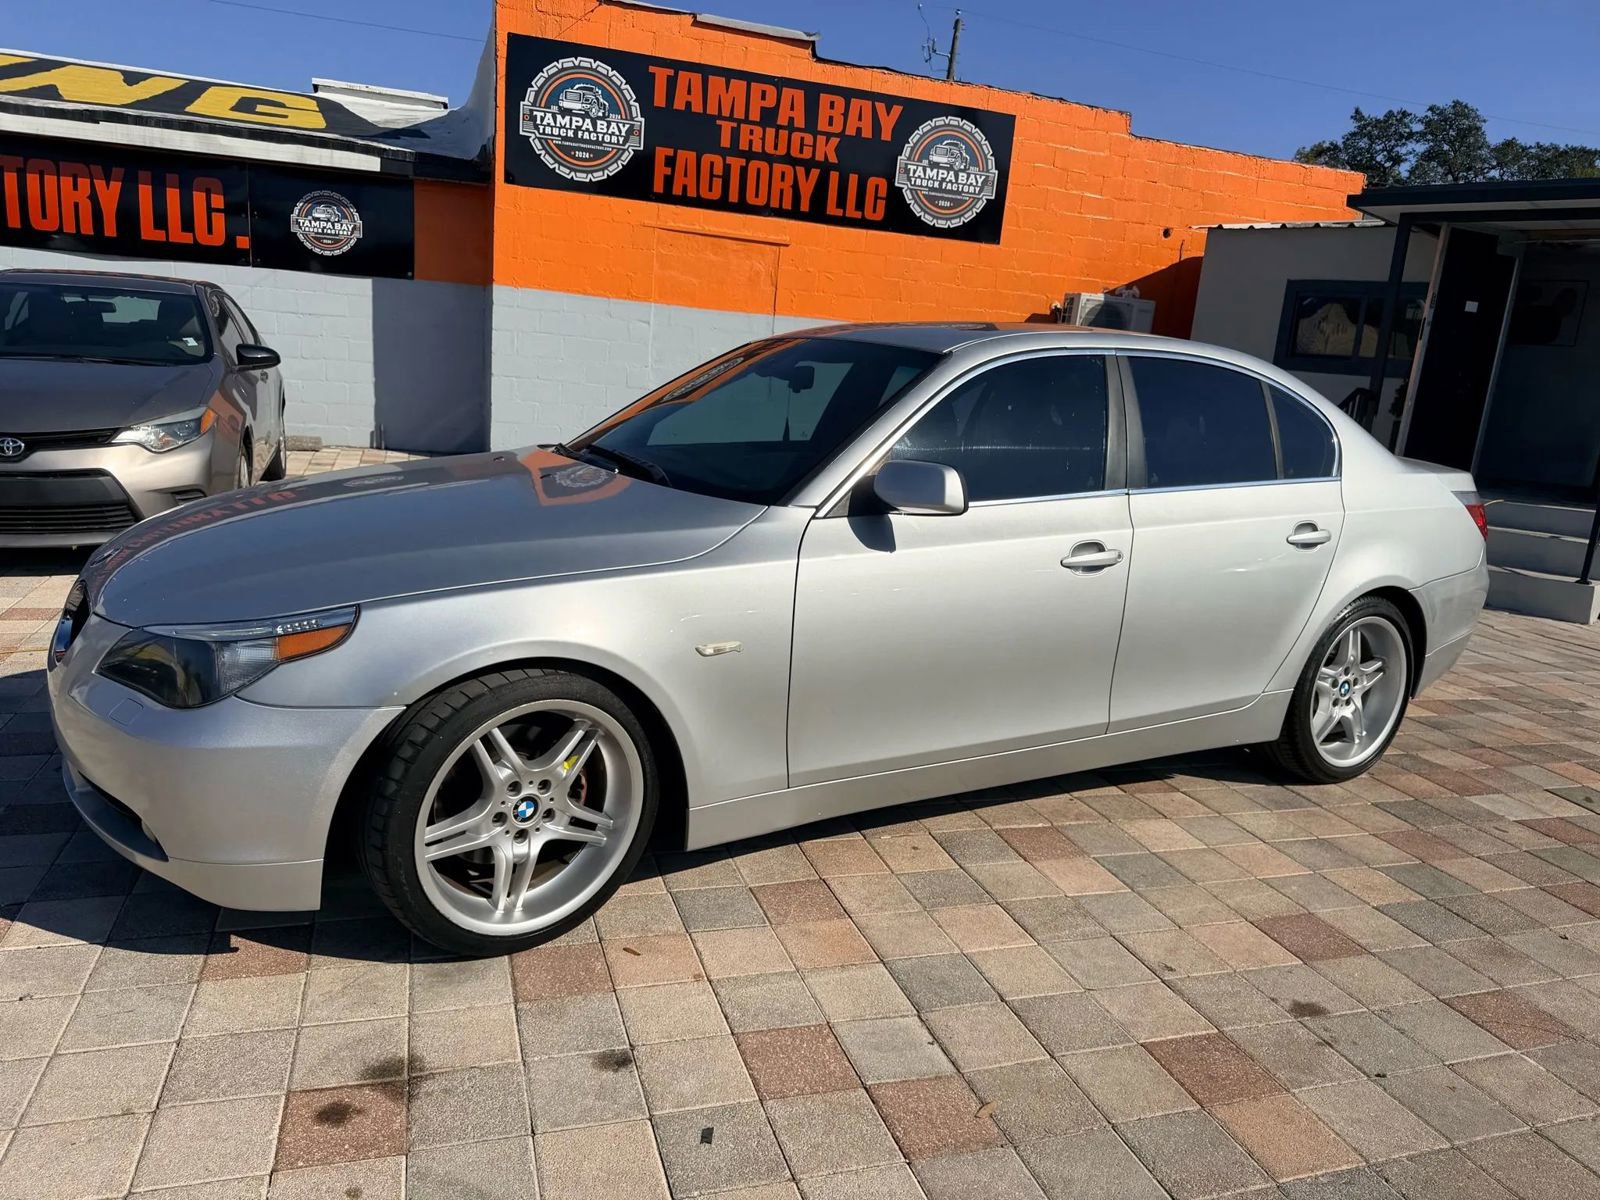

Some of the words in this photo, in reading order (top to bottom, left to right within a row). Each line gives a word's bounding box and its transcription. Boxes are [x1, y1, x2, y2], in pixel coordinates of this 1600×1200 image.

[649, 66, 805, 128] TAMPA
[817, 93, 903, 141] BAY
[533, 111, 593, 131] TAMPA
[597, 120, 630, 136] BAY
[539, 125, 574, 138] TRUCK
[578, 131, 625, 145] FACTORY
[716, 120, 840, 163] TRUCK
[653, 147, 821, 212] FACTORY
[826, 171, 888, 221] LLC
[907, 165, 958, 183] TAMPA
[958, 172, 986, 187] BAY
[911, 178, 939, 188] TRUCK
[942, 183, 980, 194] FACTORY
[298, 219, 333, 230] TAMPA
[334, 222, 354, 231] BAY
